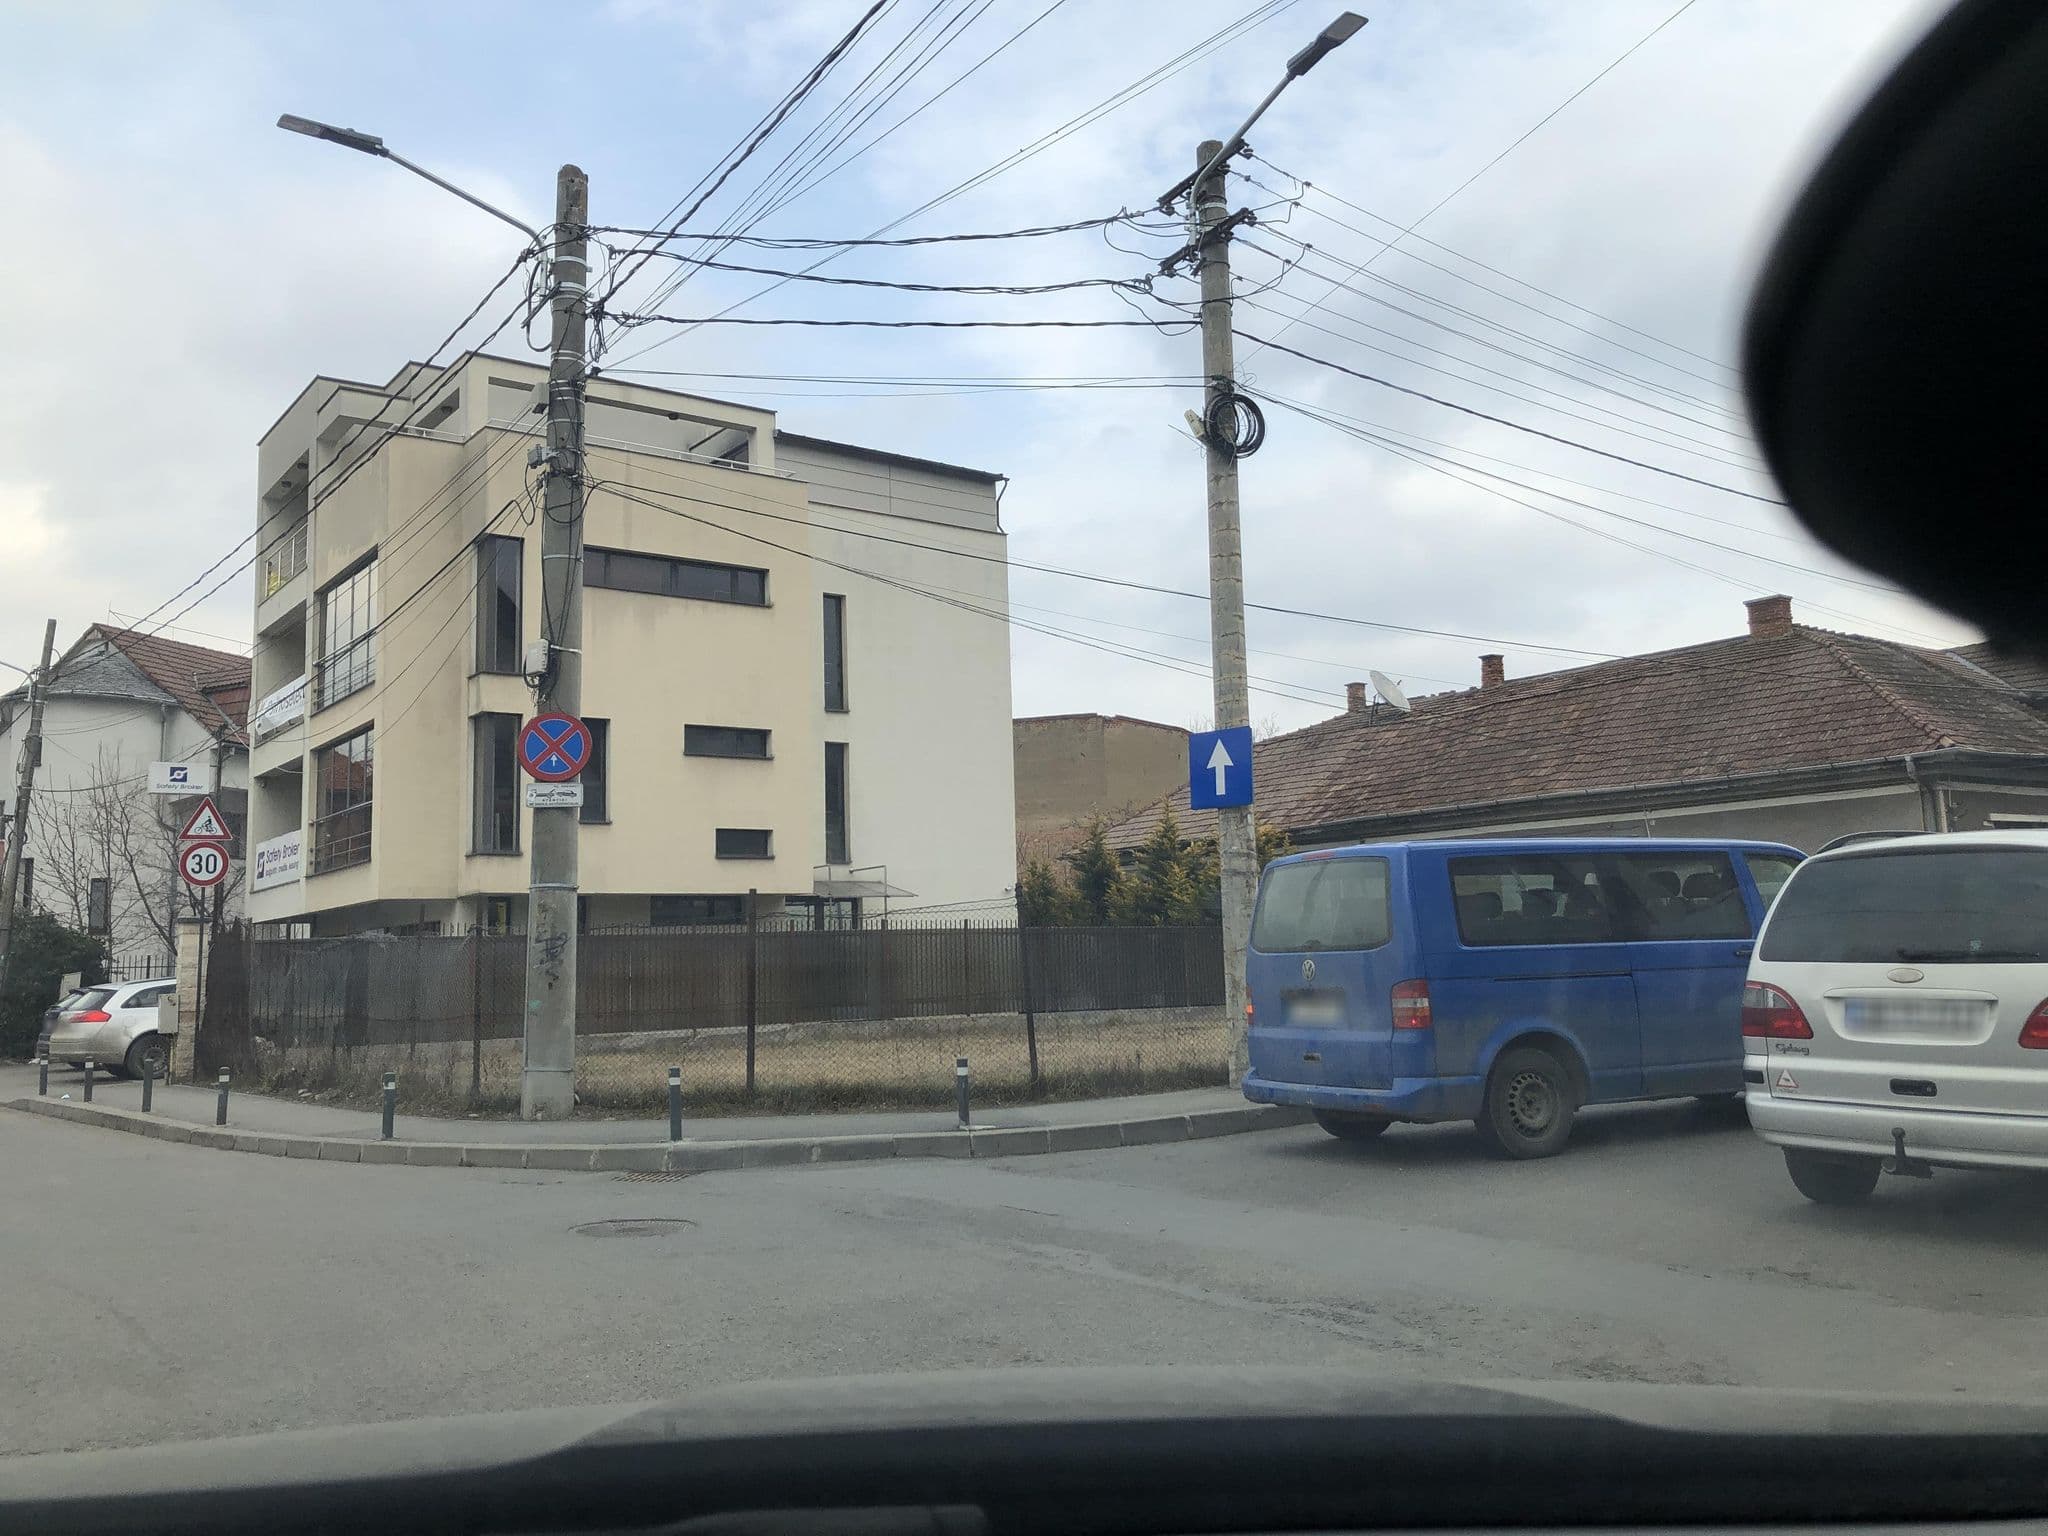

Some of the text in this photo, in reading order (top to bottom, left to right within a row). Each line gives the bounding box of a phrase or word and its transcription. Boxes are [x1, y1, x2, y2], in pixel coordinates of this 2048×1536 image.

[191, 853, 217, 874] 30
[266, 843, 300, 864] Safety Broker
